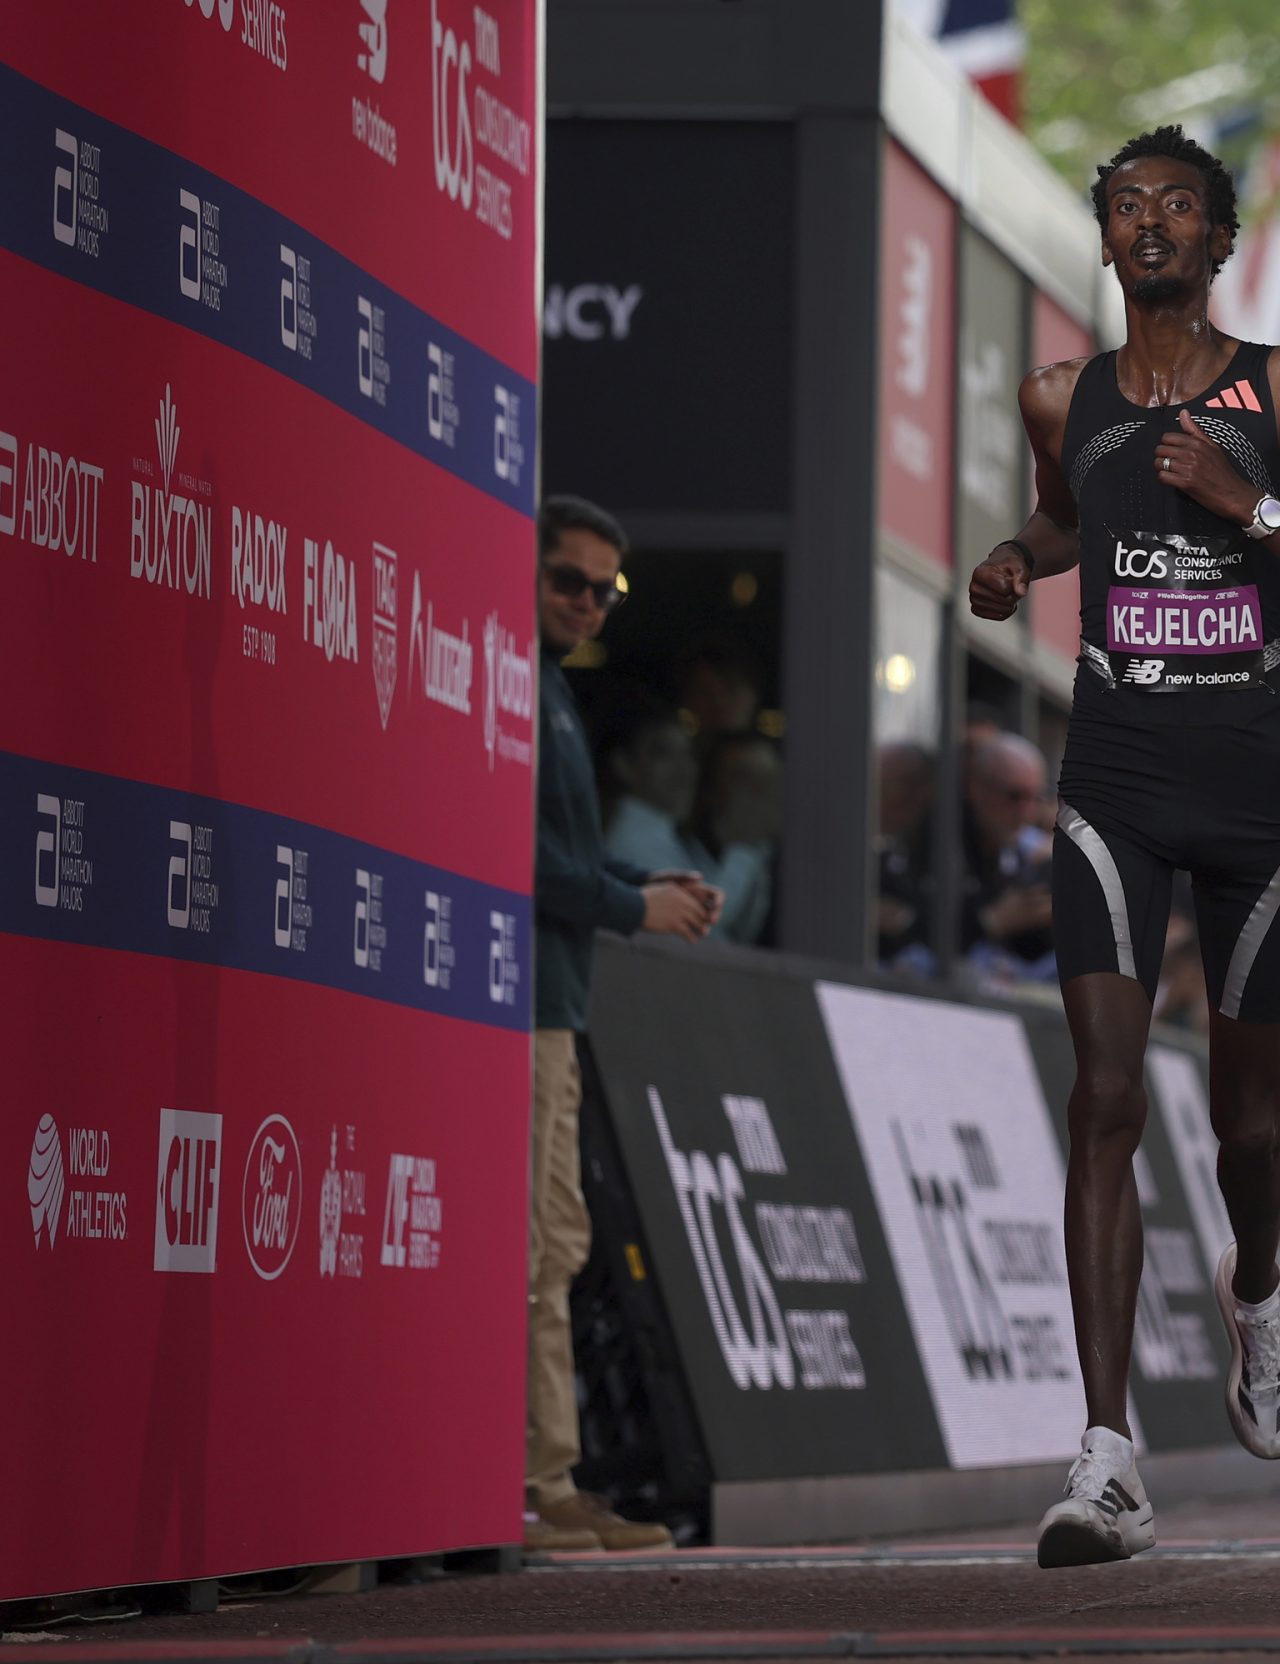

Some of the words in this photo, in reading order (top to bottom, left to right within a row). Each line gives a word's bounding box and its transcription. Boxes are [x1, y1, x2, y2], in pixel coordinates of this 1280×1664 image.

[80, 141, 101, 173] ABBOTT
[79, 171, 99, 200] WORLD
[78, 198, 109, 233] MARATHON
[78, 226, 99, 258] MAJORS
[20, 442, 104, 563] ABBOTT
[130, 480, 211, 600] BUXTON
[231, 505, 287, 615] RADOX
[1115, 541, 1168, 579] tcs
[1174, 553, 1244, 568] CONSUANCY
[1174, 569, 1223, 580] SERVICES
[304, 537, 359, 664] FLORA
[1112, 604, 1258, 647] KEJELCHA
[1165, 674, 1193, 685] new
[1196, 671, 1250, 685] balance
[62, 799, 85, 828] ABBOTT
[61, 829, 83, 854] WORLD
[61, 856, 93, 885] MARATHON
[60, 885, 83, 912] MAJORS
[69, 1128, 110, 1176] WORLD
[253, 1136, 293, 1249] Ford
[67, 1190, 127, 1240] ATHLETICS
